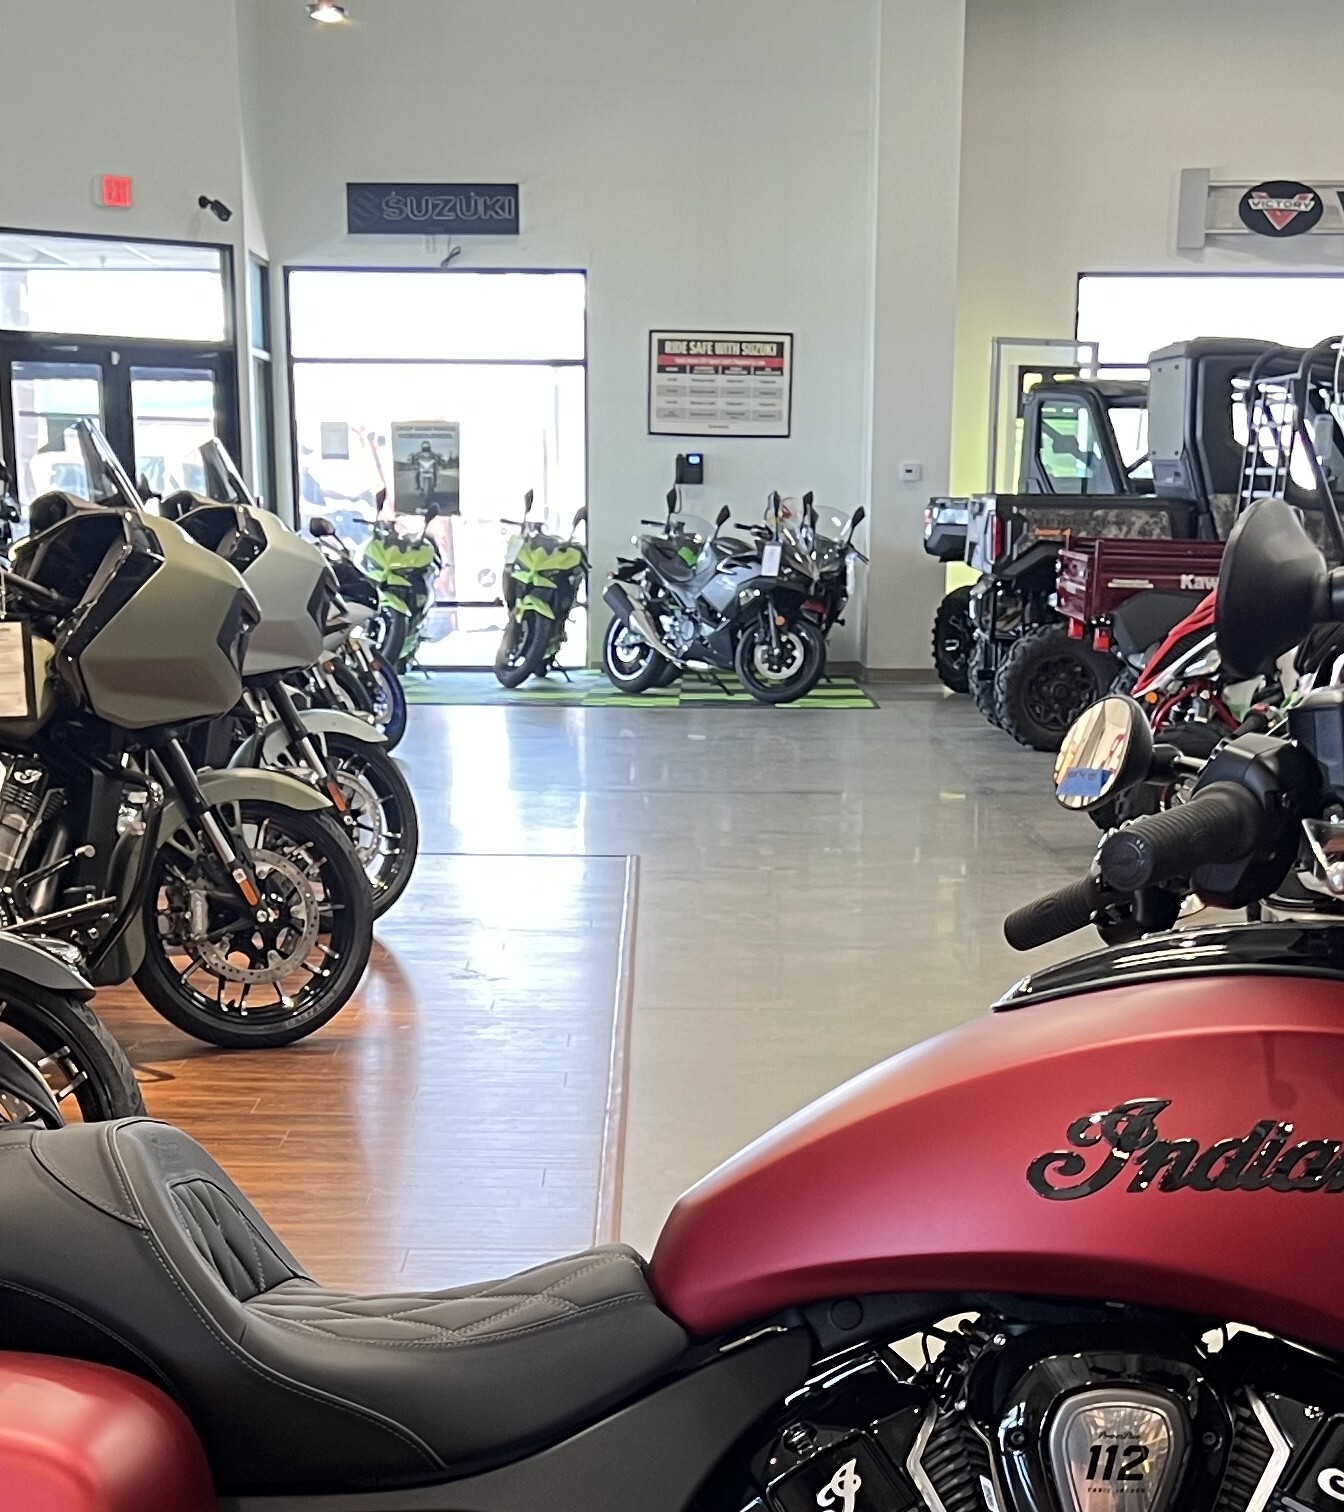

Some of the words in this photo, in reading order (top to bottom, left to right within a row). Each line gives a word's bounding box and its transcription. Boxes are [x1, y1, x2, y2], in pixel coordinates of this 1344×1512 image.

[382, 194, 516, 221] SUZUKI
[1251, 200, 1312, 209] VICTORY
[664, 341, 687, 355] RIDE
[689, 341, 714, 355] SAFE
[714, 342, 740, 356] WITH
[741, 342, 777, 357] SUZUKI
[1085, 1444, 1150, 1481] 112
